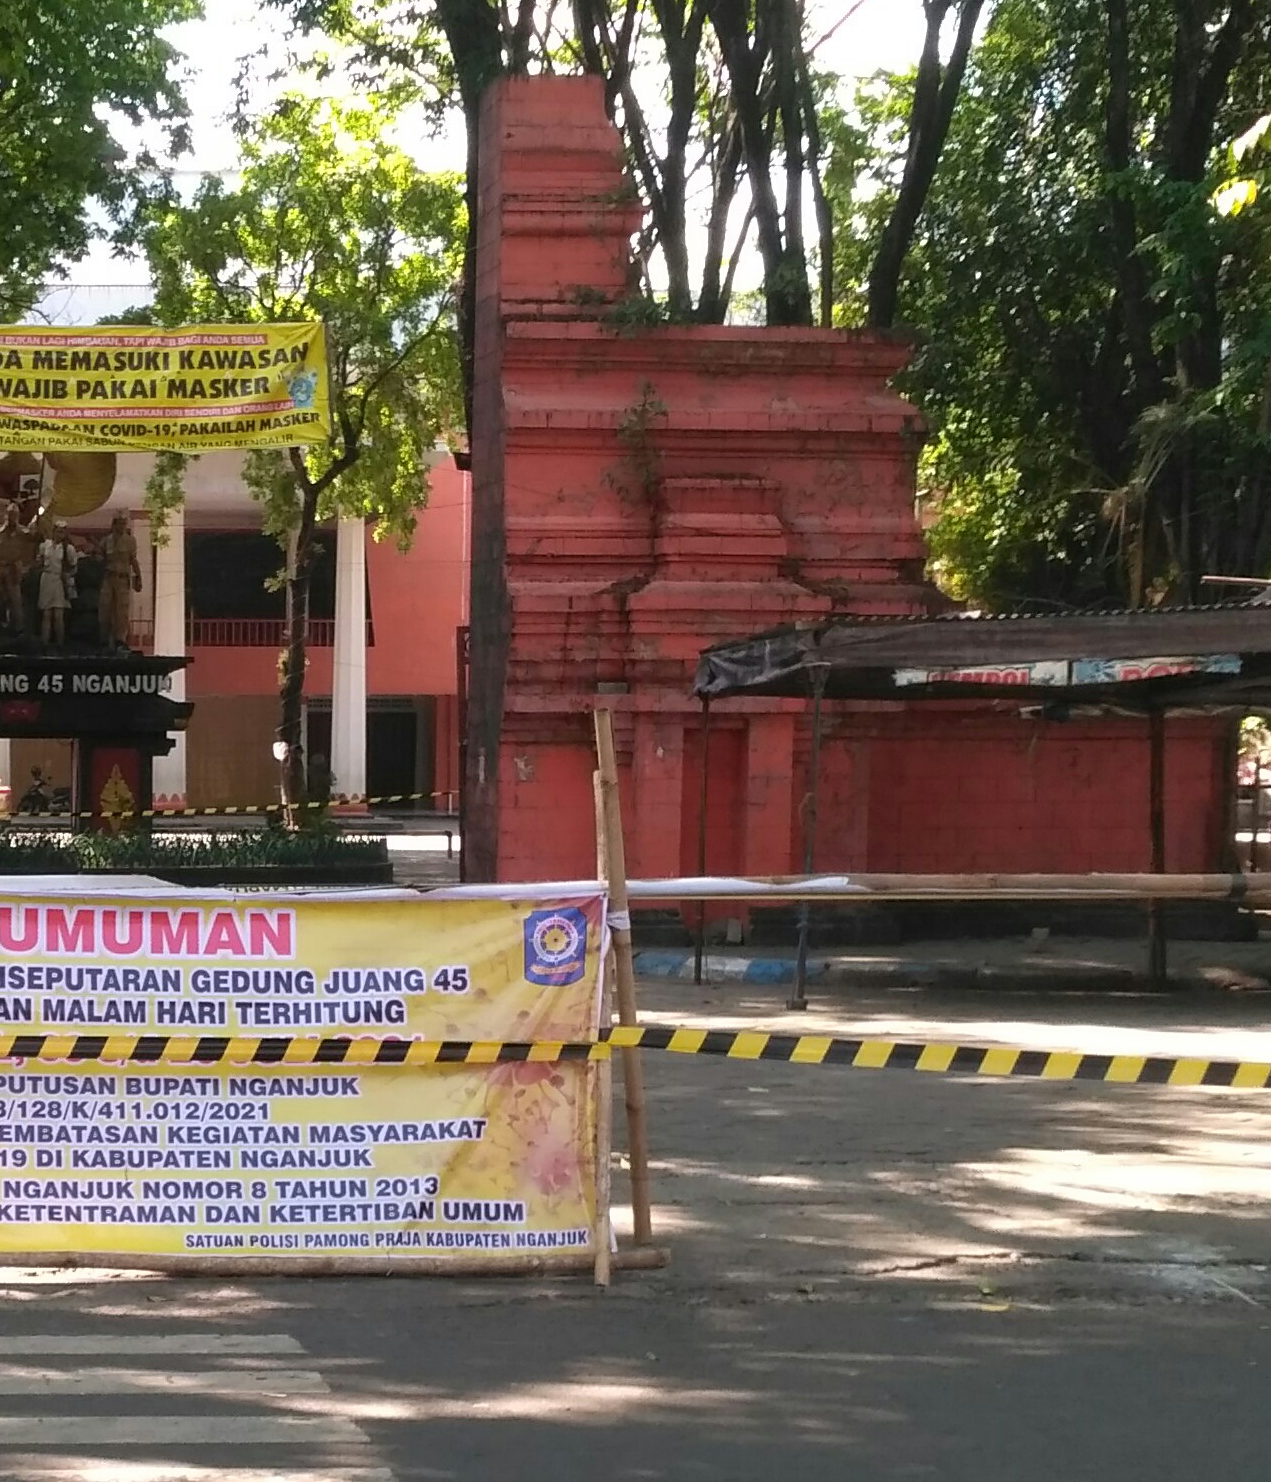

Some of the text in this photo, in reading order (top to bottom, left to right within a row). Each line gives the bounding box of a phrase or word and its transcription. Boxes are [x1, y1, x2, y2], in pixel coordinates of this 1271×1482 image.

[178, 335, 201, 345] BAGI
[203, 335, 229, 344] ANDA
[230, 335, 265, 344] SEMUA
[32, 350, 170, 371] MEMASUKI
[180, 342, 309, 371] KAWASAN
[76, 379, 157, 400] PAKAI
[166, 376, 270, 399] MASKER
[57, 409, 81, 417] ANDA
[222, 406, 242, 415] DAN
[180, 420, 255, 436] PAKAILAH
[260, 412, 321, 431] MASKER
[48, 436, 83, 446] PAKAI
[37, 675, 63, 693] 45
[192, 970, 313, 993] GEDUNG
[325, 970, 423, 993] JUANG
[434, 969, 467, 991] 45
[44, 999, 145, 1023] MALAM
[158, 1001, 225, 1024] HARI
[236, 1000, 404, 1024] TERHITUNG
[126, 1078, 219, 1095] BUPATI
[230, 1078, 358, 1095] NGANJUK
[169, 1127, 299, 1143] KEGIATAN
[310, 1121, 484, 1142] MASYARAKAT
[37, 1150, 63, 1166] DI
[73, 1150, 230, 1167] KABUPATEN
[242, 1150, 371, 1167] NGANJUK
[5, 1181, 133, 1198] NGANJUK
[144, 1182, 242, 1198] NOMOR
[252, 1182, 266, 1198] 8
[275, 1181, 366, 1198] TAHUN
[377, 1177, 438, 1196] 2013
[206, 1206, 259, 1222] DAN
[271, 1202, 433, 1222] KETERTIBAN
[444, 1202, 523, 1221] UMUM
[187, 1231, 586, 1248] SATUAN POLISI PAMONG PRAJA KABUPATEN NGANJUK
